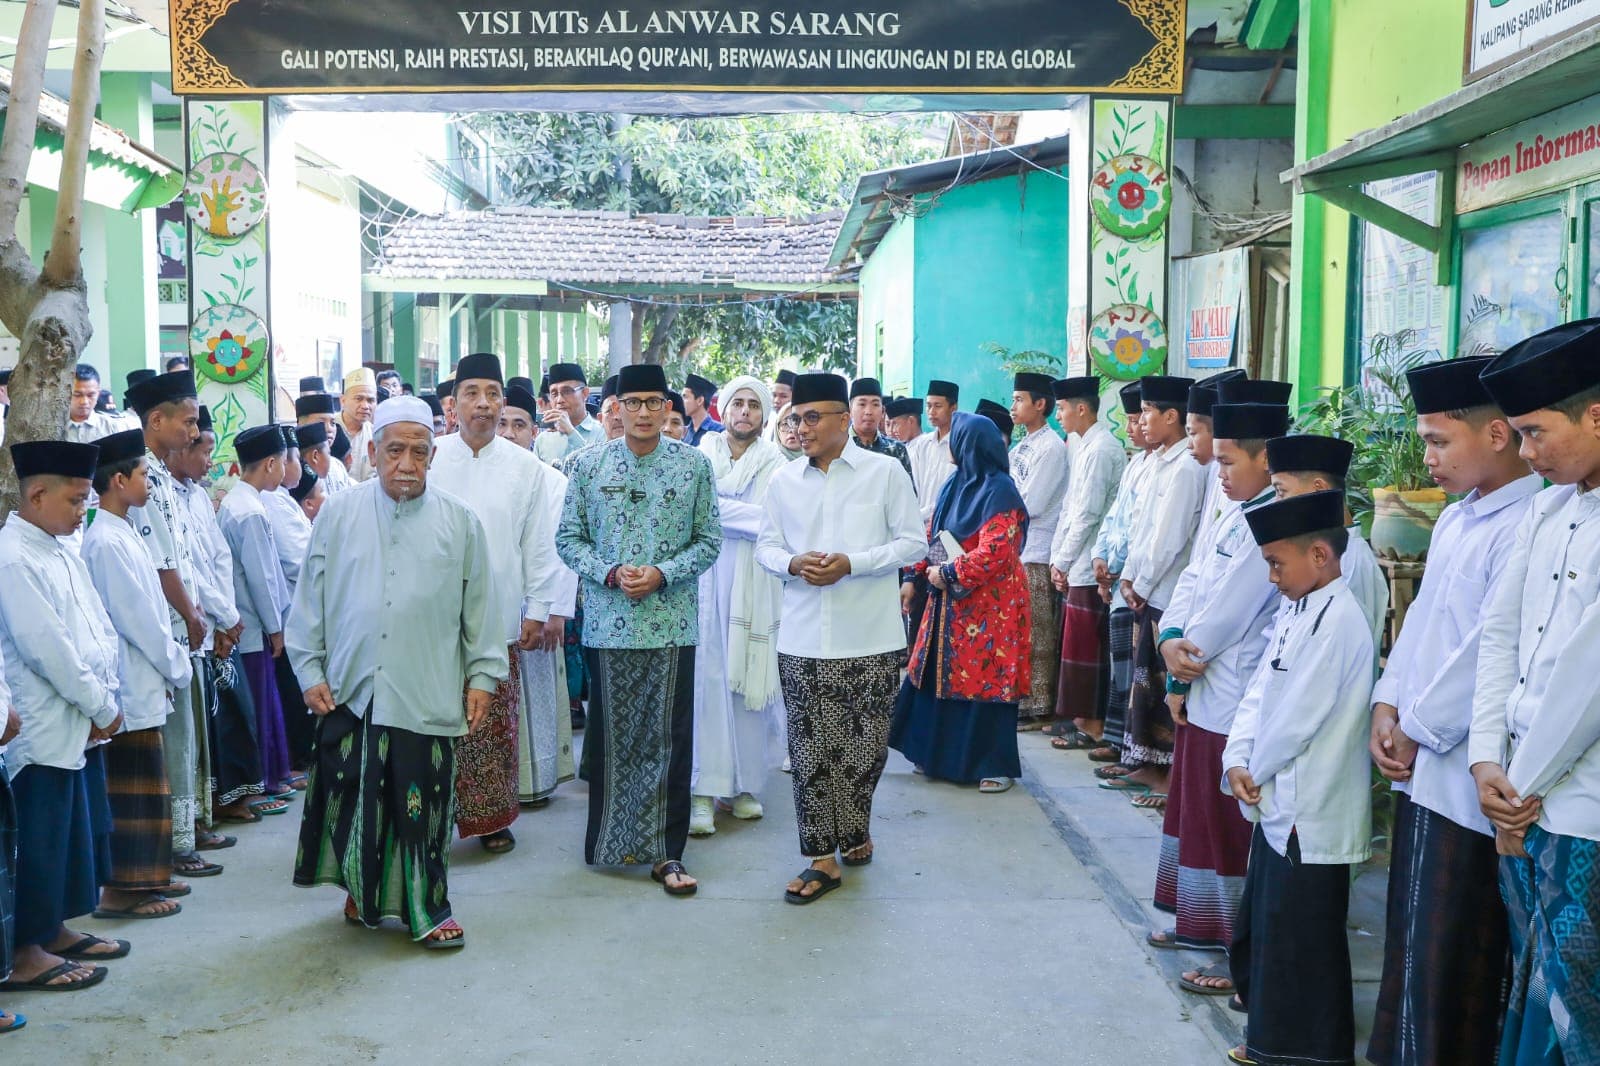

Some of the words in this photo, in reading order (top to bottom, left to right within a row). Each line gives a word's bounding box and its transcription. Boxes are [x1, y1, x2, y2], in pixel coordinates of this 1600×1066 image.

[458, 11, 522, 34] VISI
[530, 11, 588, 34] MTs
[595, 11, 638, 34] AL
[643, 11, 761, 34] ANWAR
[769, 12, 901, 36] SARANG
[1480, 18, 1517, 50] KALIPANG
[1518, 4, 1553, 32] SARANG
[1555, 0, 1583, 14] REM
[280, 49, 320, 70] GALI
[324, 49, 400, 72] POTENSI,
[404, 48, 445, 69] RAIH
[449, 47, 529, 71] PRESTASI,
[534, 47, 634, 71] BERAKHLAQ
[719, 47, 831, 69] BERWAWASAN
[836, 48, 948, 70] LINGKUNGAN
[953, 50, 971, 69] DI
[975, 50, 1008, 69] ERA
[1011, 49, 1076, 69] GLOBAL
[1463, 154, 1511, 192] Papan
[191, 307, 259, 342] RAPI
